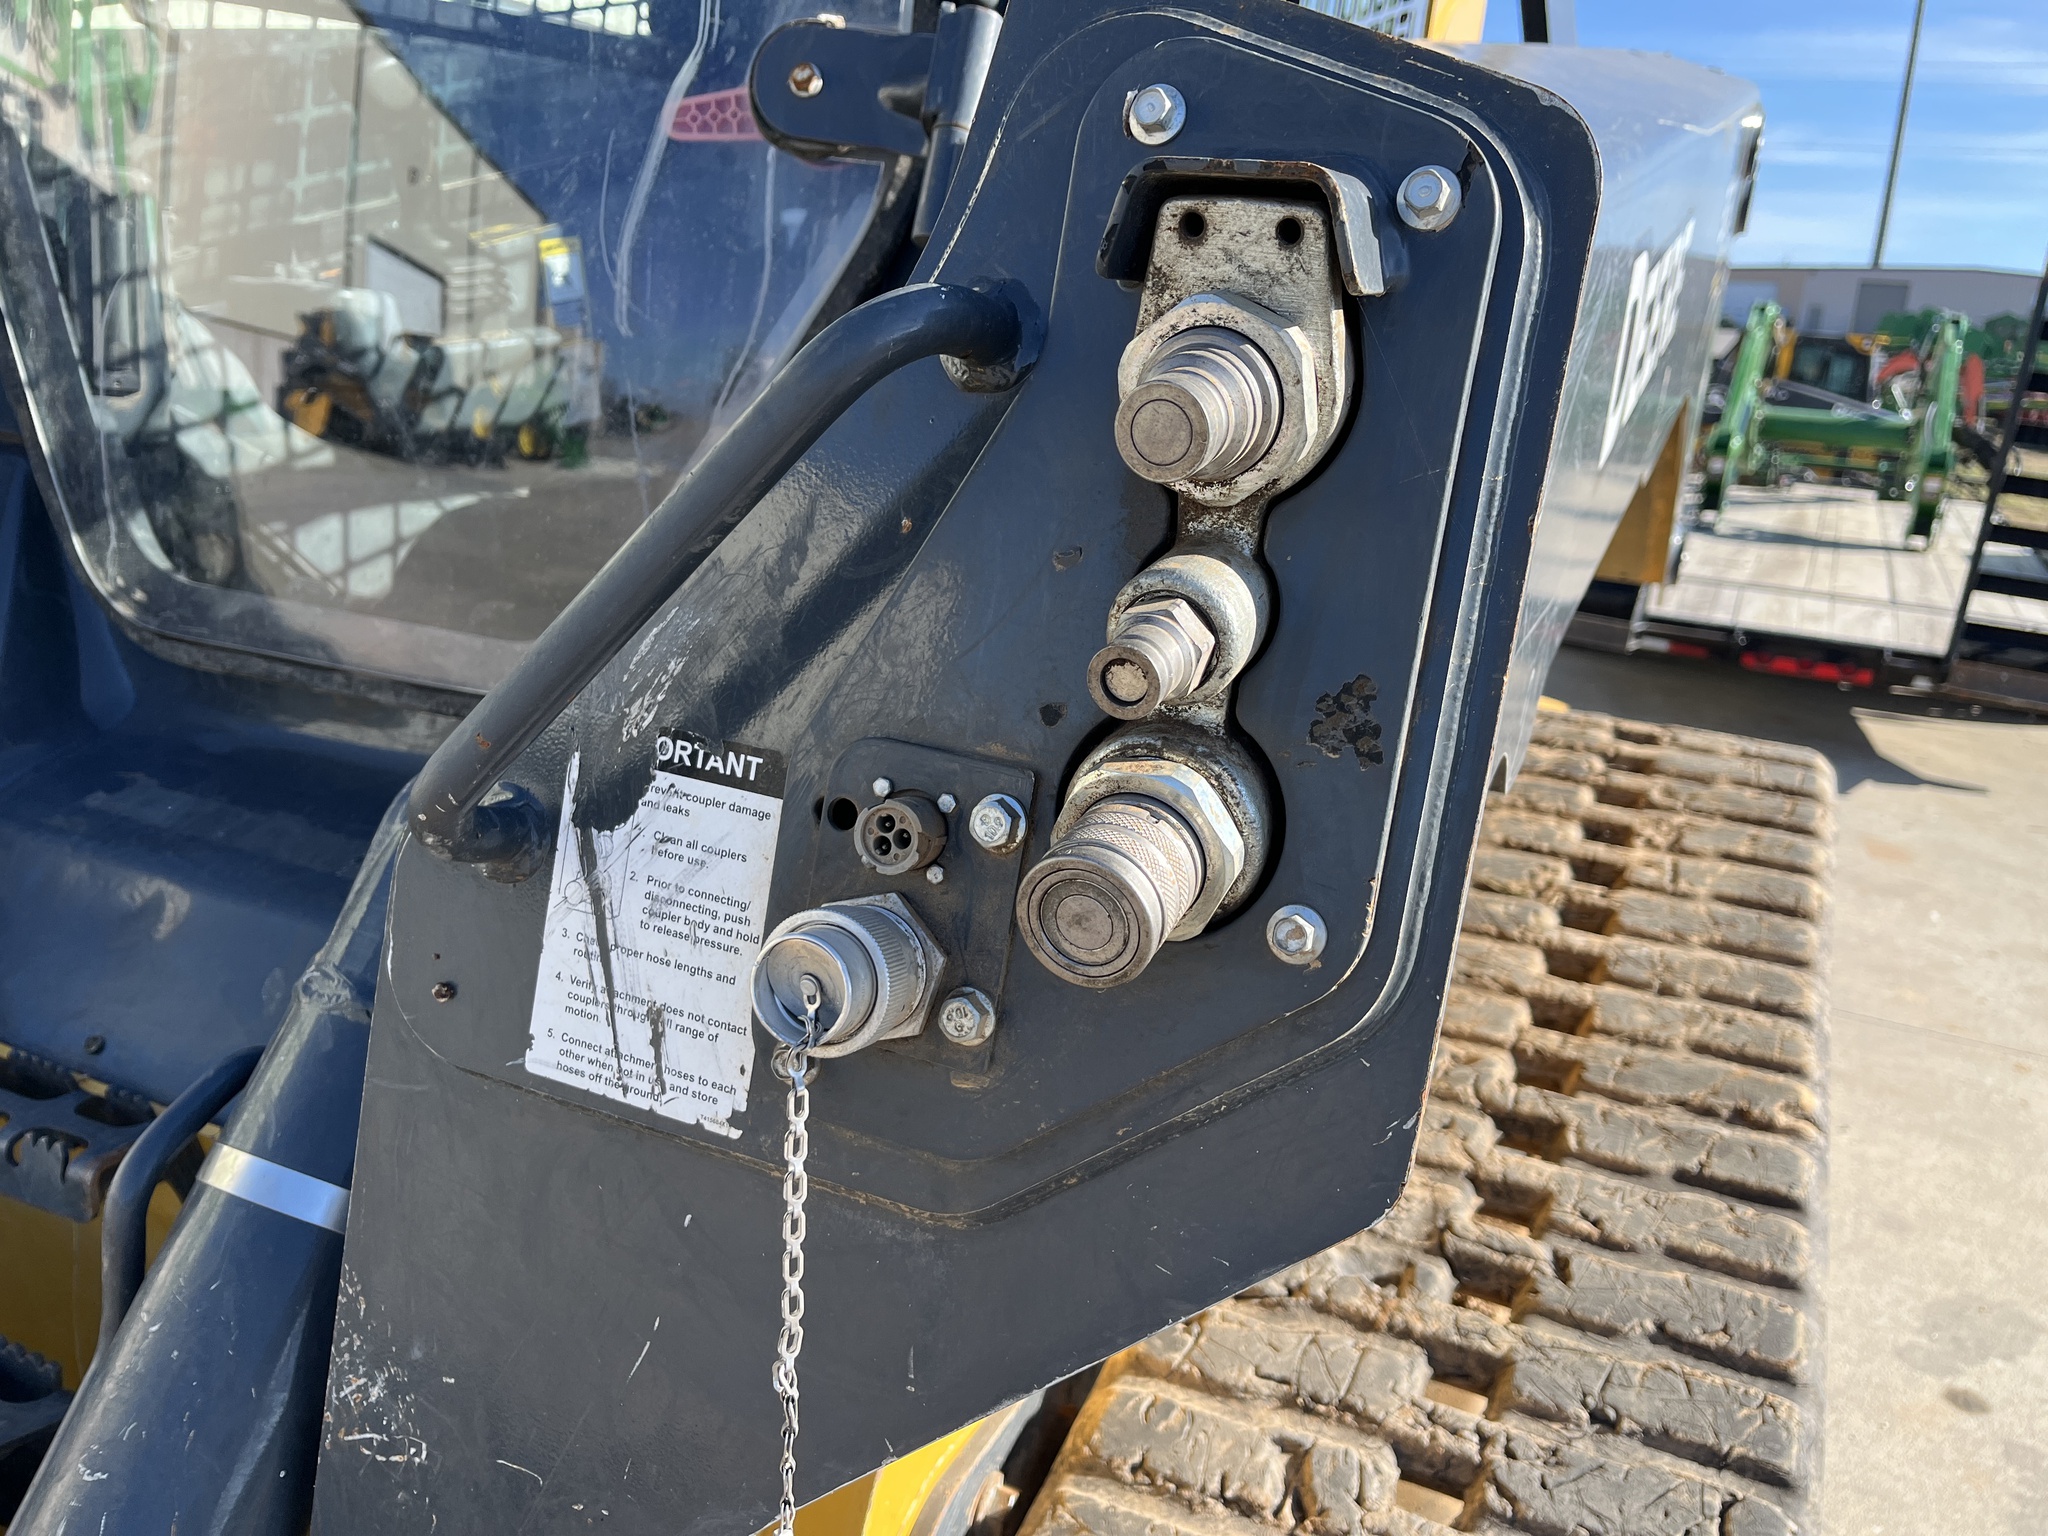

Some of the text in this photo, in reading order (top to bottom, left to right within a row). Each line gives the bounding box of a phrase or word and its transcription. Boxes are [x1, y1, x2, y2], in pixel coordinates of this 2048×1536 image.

[641, 798, 691, 817] and leaks
[686, 793, 726, 809] coupler
[728, 801, 771, 821] damage
[653, 830, 748, 863] Clan all couplers
[687, 855, 709, 869] use.
[629, 870, 751, 912] 2. Prior to connecting/
[644, 890, 751, 927] disconnecting, push
[640, 919, 742, 956] to release pressure.
[642, 906, 760, 945] coupler body and hold
[562, 927, 570, 939] 3.
[609, 943, 644, 959] proper
[646, 951, 671, 968] hose
[674, 959, 713, 979] lengths
[715, 975, 736, 986] and
[555, 971, 564, 982] 4.
[660, 1002, 685, 1018] does
[687, 1011, 705, 1024] not
[708, 1018, 748, 1036] contact
[564, 1005, 601, 1023] motion.
[567, 991, 610, 1010] couplers
[675, 1022, 705, 1040] range
[707, 1033, 720, 1043] of
[547, 1027, 555, 1039] 5.
[561, 1032, 603, 1054] Connect
[664, 1063, 695, 1083] hoses
[698, 1075, 709, 1087] to
[711, 1081, 737, 1096] each
[556, 1060, 585, 1078] hoses
[588, 1072, 603, 1083] off
[604, 1076, 621, 1089] the
[559, 1048, 585, 1063] other
[587, 1055, 614, 1072] when
[635, 1069, 645, 1082] in
[669, 1082, 689, 1096] and
[691, 1089, 719, 1105] store
